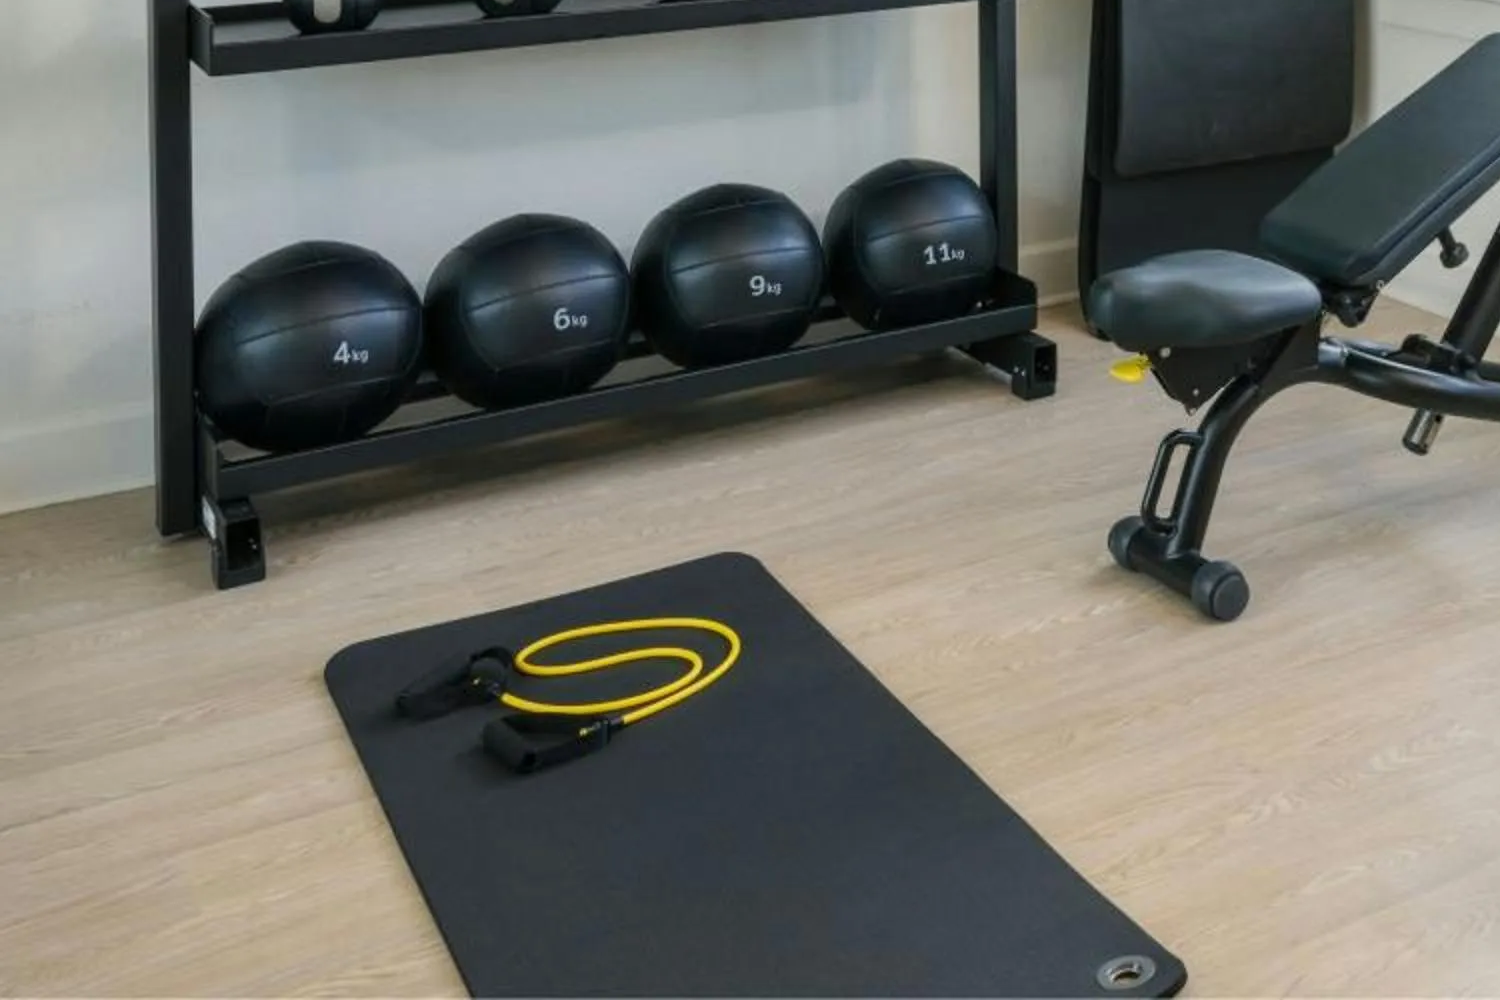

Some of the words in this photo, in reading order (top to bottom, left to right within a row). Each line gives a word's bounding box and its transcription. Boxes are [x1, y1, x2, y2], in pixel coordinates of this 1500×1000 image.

[924, 242, 965, 265] 11kg
[749, 275, 781, 297] 9kg
[553, 308, 588, 330] 6kg
[333, 341, 368, 364] 4kg
